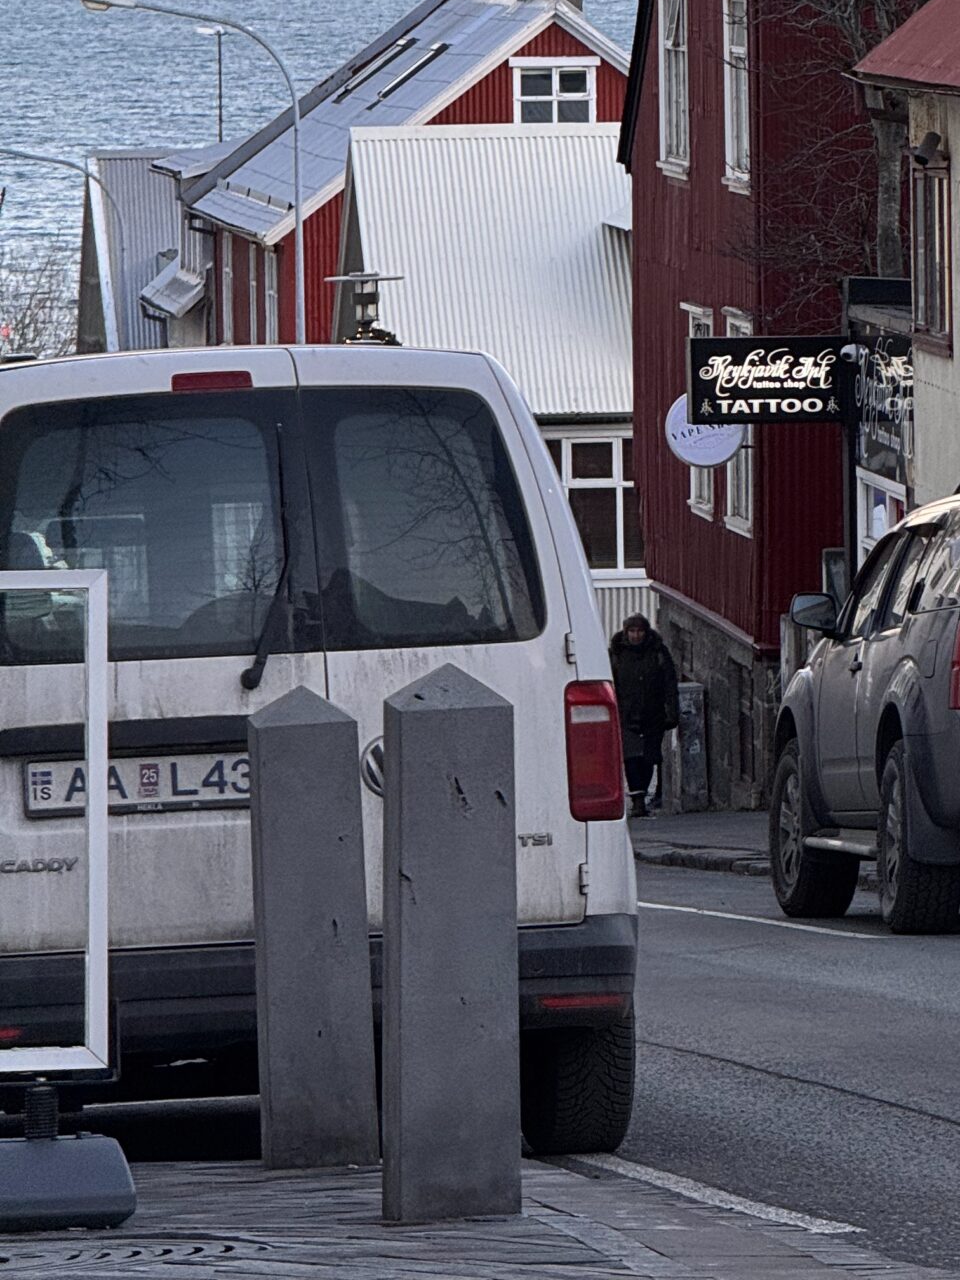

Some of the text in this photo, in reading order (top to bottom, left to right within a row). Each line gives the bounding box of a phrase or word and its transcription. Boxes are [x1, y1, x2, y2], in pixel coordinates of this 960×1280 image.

[699, 348, 837, 397] Reykjavik Ink
[753, 379, 806, 389] tattoo shop
[716, 398, 823, 414] TATTOO
[142, 769, 158, 783] 25
[33, 786, 52, 801] IS
[518, 832, 553, 848] TSI
[0, 857, 79, 875] CADDY
